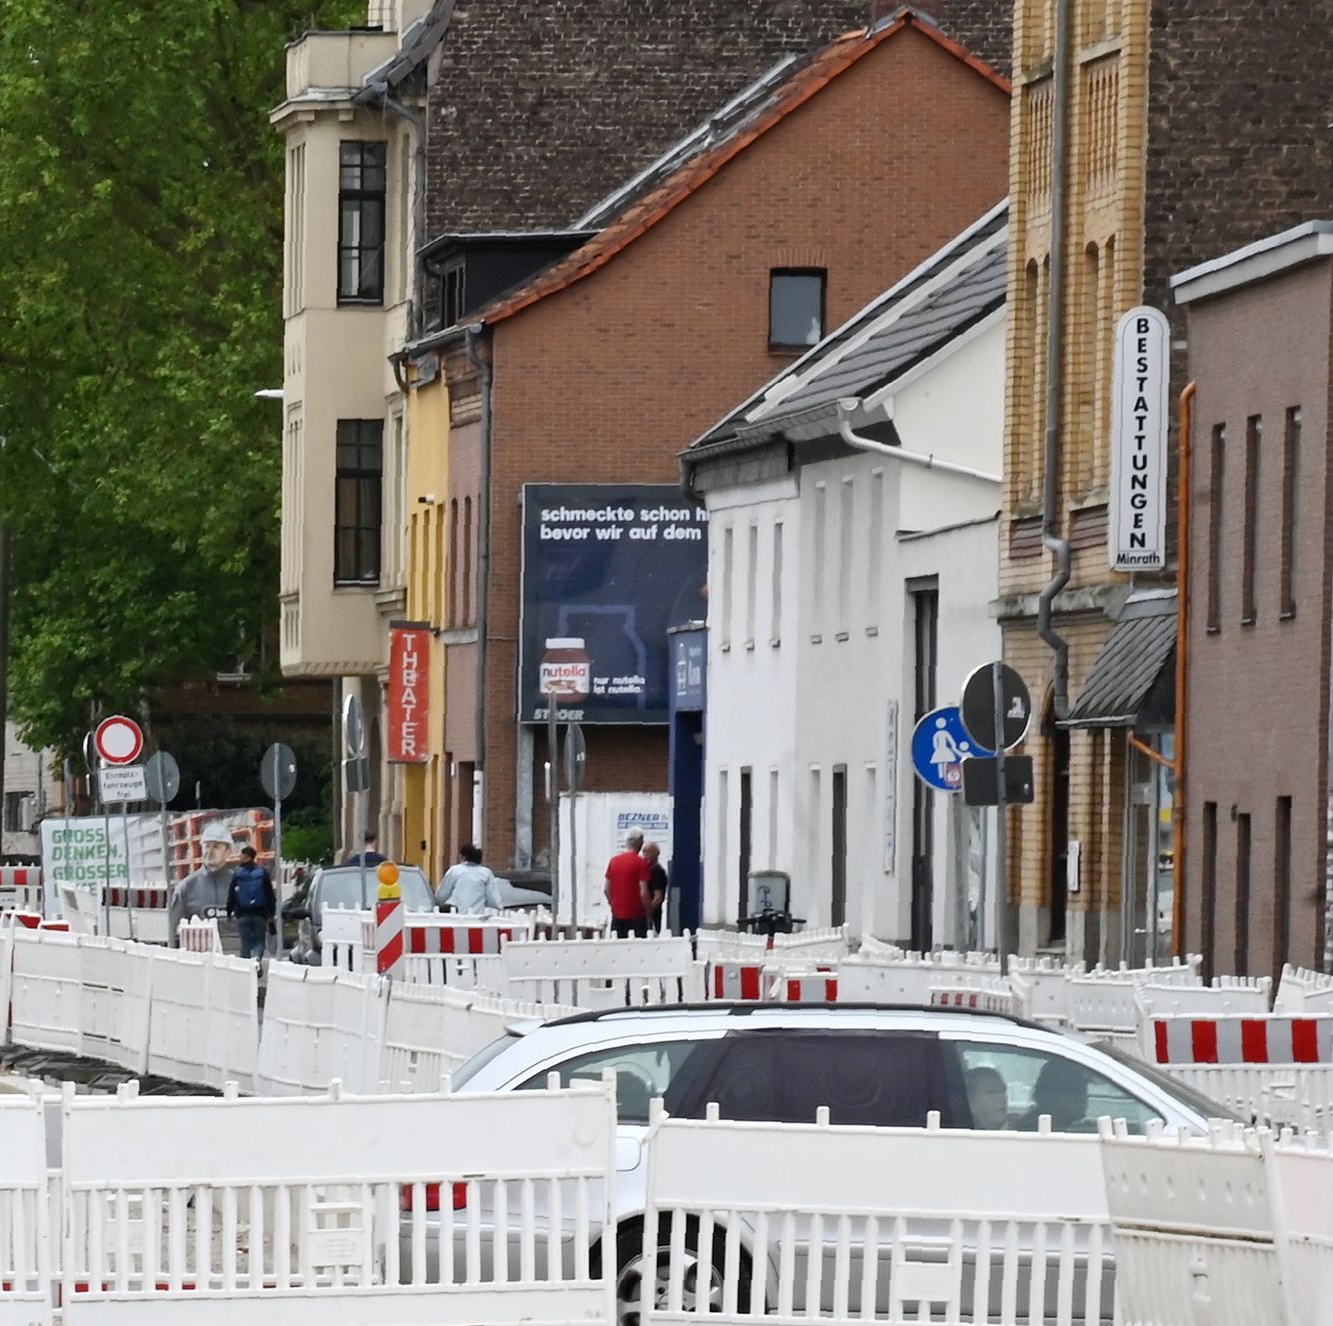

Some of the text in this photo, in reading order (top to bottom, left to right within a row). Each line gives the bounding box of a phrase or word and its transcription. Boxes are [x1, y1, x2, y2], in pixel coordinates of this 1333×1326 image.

[1130, 318, 1149, 549] BESTATTUNGEN
[541, 506, 634, 522] schmeckte
[640, 506, 690, 521] schon
[540, 525, 701, 540] bevor wir auf dem
[1116, 551, 1161, 565] Minrath
[542, 666, 586, 677] nutella
[613, 675, 645, 684] nutella
[401, 633, 419, 756] THEATER
[533, 709, 584, 720] STÖER
[52, 829, 105, 843] GROSS
[52, 844, 123, 861] DENKEN.
